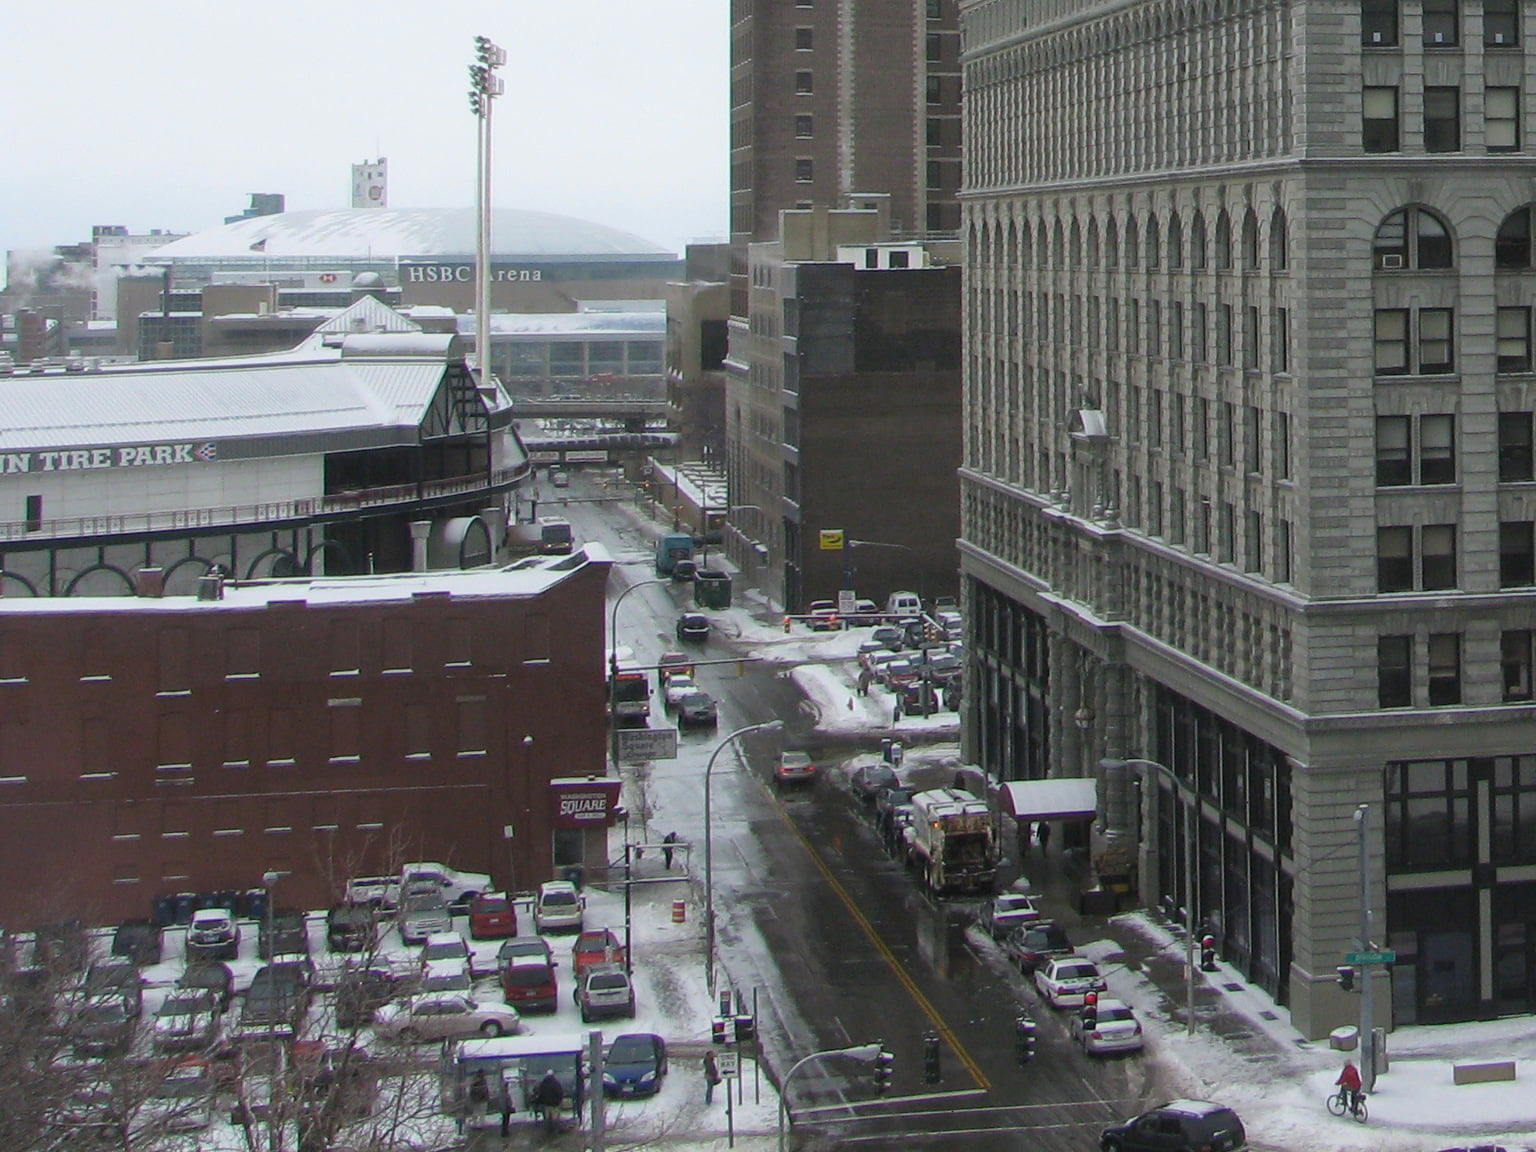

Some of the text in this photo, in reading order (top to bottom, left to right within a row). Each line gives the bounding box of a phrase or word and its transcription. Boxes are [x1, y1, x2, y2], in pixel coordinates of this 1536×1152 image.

[408, 265, 471, 282] HSBC
[39, 448, 112, 472] TIRE
[119, 444, 194, 467] PARK
[560, 799, 607, 816] SQUARE
